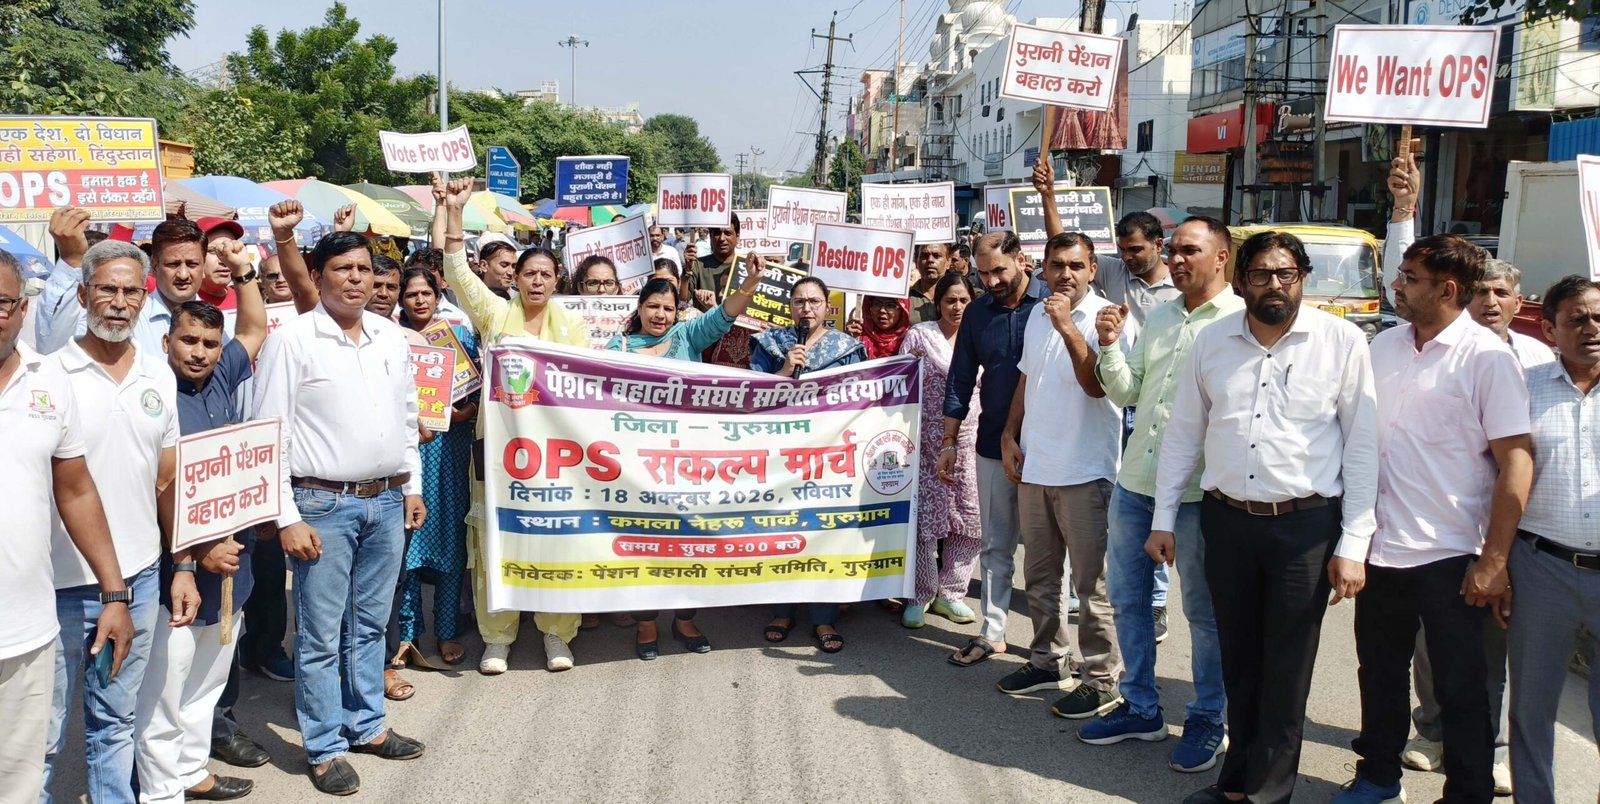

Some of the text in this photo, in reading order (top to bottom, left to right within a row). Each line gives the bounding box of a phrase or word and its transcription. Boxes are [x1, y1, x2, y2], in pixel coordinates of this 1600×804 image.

[1016, 41, 1112, 69] पुरानी पेंशन
[1016, 70, 1103, 96] बहाल करो
[1337, 54, 1488, 99] We Want OPS
[0, 122, 142, 143] एक देश, दो विधान
[28, 144, 83, 163] सहेगा,
[88, 144, 153, 166] हिंदुस्तान
[387, 138, 469, 163] Vote For OPS
[80, 170, 149, 188] हमारा हक है
[569, 181, 617, 193] पुरानी पेंशन
[573, 171, 613, 182] मजबूरी है
[0, 171, 71, 208] OPS
[76, 188, 97, 205] इसे
[101, 189, 129, 204] लेकर
[562, 194, 583, 203] बहुत
[662, 188, 726, 213] Restore OPS
[1081, 191, 1096, 203] हो
[870, 197, 881, 210] एक
[882, 194, 889, 210] ही
[909, 196, 921, 210] एक
[922, 193, 930, 209] ही
[931, 195, 945, 208] नारा
[1020, 207, 1035, 216] या
[772, 200, 791, 230] पुरानी
[791, 200, 810, 226] पेंशन
[931, 216, 950, 230] हमारा
[987, 203, 1006, 227] We
[816, 240, 906, 279] Restore OPS
[563, 298, 588, 310] जो
[752, 293, 783, 311] पेंशन
[745, 307, 772, 321] बन्द
[545, 362, 607, 401] पेंशन
[611, 376, 687, 406] बहाली
[691, 379, 750, 409] संघर्ष
[753, 381, 823, 408] समिति
[825, 374, 910, 405] हरियाणा
[611, 412, 678, 434] जिला
[718, 419, 811, 441] गुरुग्राम
[503, 431, 858, 485] OPS संकल्प मार्च
[184, 441, 275, 499] पुरानी पेंशन
[187, 475, 269, 525] बहाल करो
[509, 480, 573, 502] दिनांक
[600, 487, 628, 503] 18
[638, 489, 710, 512] अक्टूबर
[718, 489, 784, 505] 2026,
[791, 481, 853, 501] रविवार
[516, 515, 581, 529] स्थान
[608, 516, 682, 530] कमला
[688, 513, 745, 531] नेहरू
[752, 509, 808, 528] पार्क,
[816, 508, 891, 529] गुरुग्राम
[617, 540, 660, 553] समय
[679, 541, 716, 556] सुबह
[724, 541, 768, 553] 9:00
[774, 537, 802, 551] बजे
[590, 564, 640, 580] पेंशन
[646, 564, 707, 579] बहाली
[714, 561, 763, 578] संघर्ष
[769, 557, 834, 575] समिति,
[842, 556, 904, 576] गुरुग्राम
